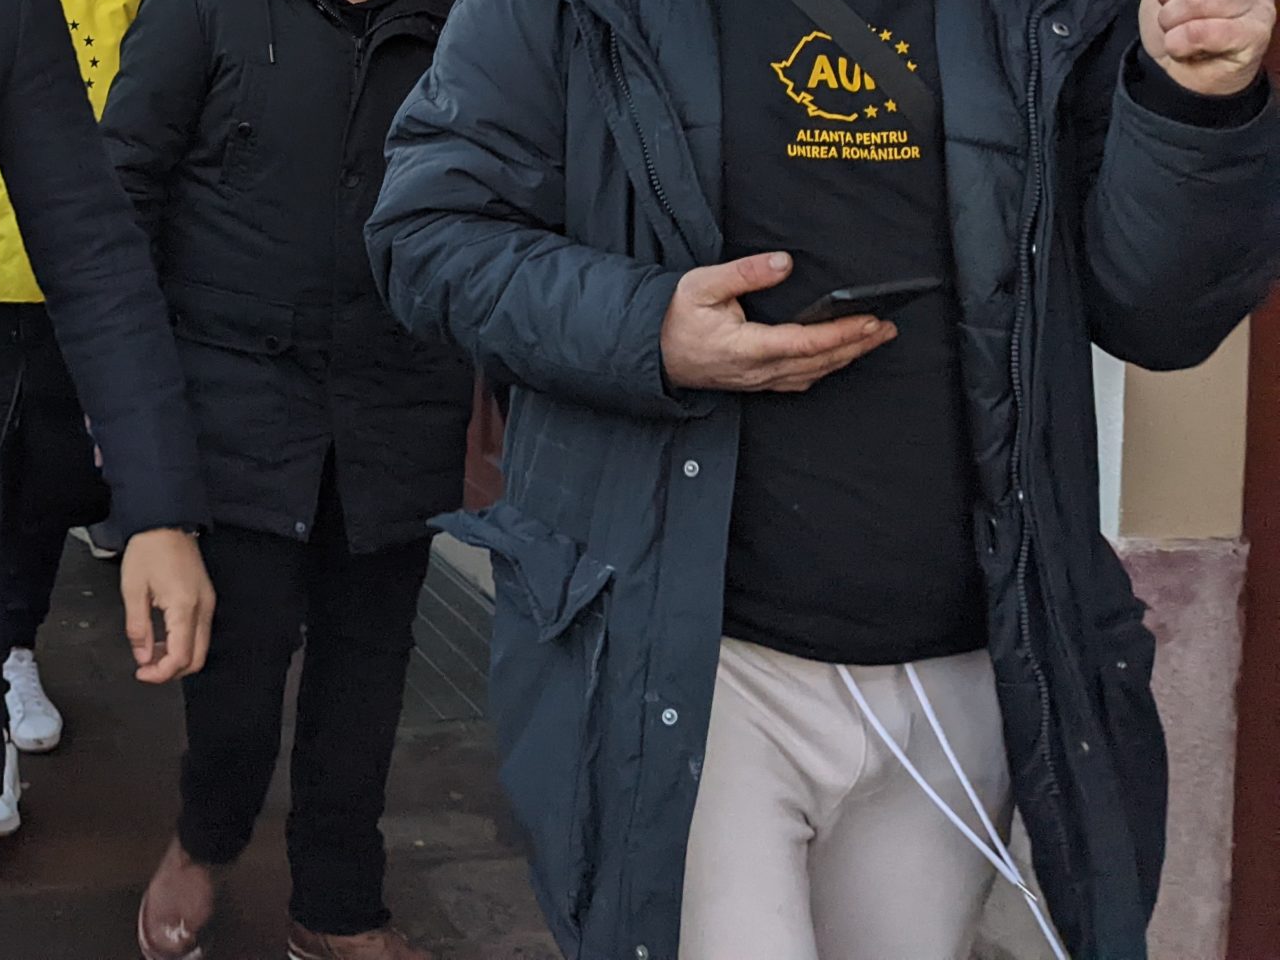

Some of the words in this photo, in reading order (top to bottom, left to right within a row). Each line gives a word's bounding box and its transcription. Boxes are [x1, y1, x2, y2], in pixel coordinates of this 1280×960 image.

[855, 130, 908, 145] PENTRU
[787, 144, 838, 159] UNIREA
[842, 144, 920, 161] ROMÂNILOR
